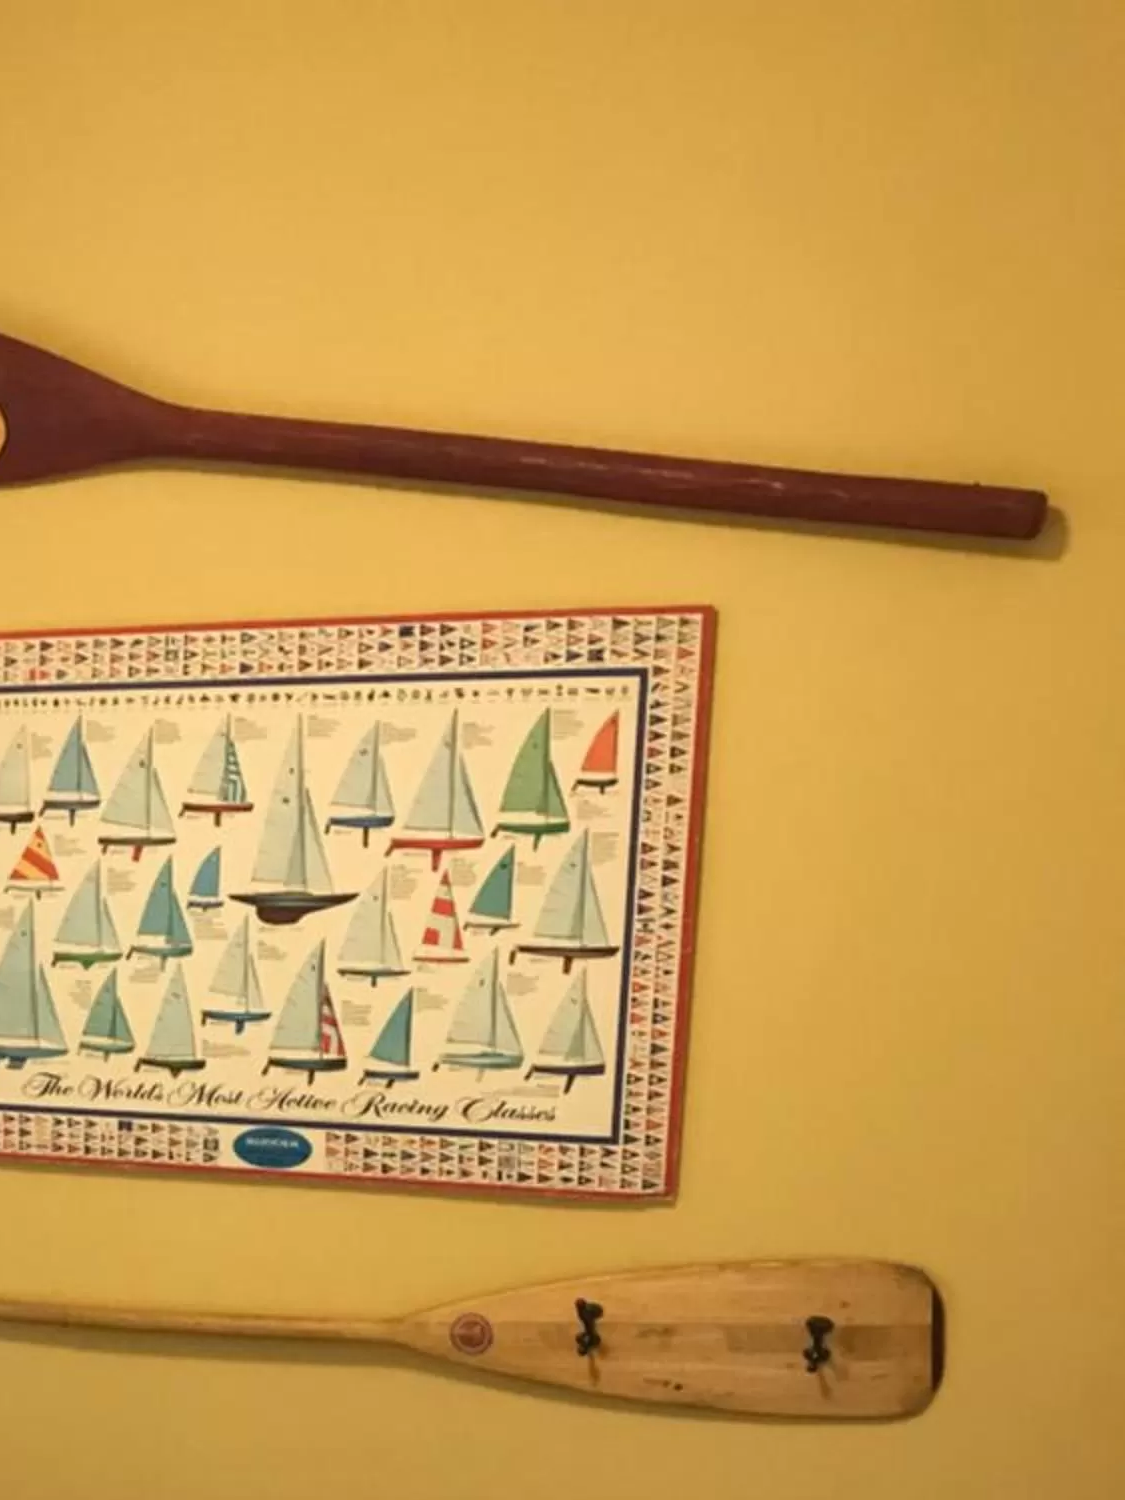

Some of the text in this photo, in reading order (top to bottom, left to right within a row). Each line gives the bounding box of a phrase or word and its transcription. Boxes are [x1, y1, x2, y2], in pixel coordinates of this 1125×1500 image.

[23, 1071, 75, 1097] The
[167, 1081, 243, 1109] Most
[245, 1086, 335, 1111] Active
[341, 1091, 449, 1121] Racing
[455, 1096, 557, 1123] Classes
